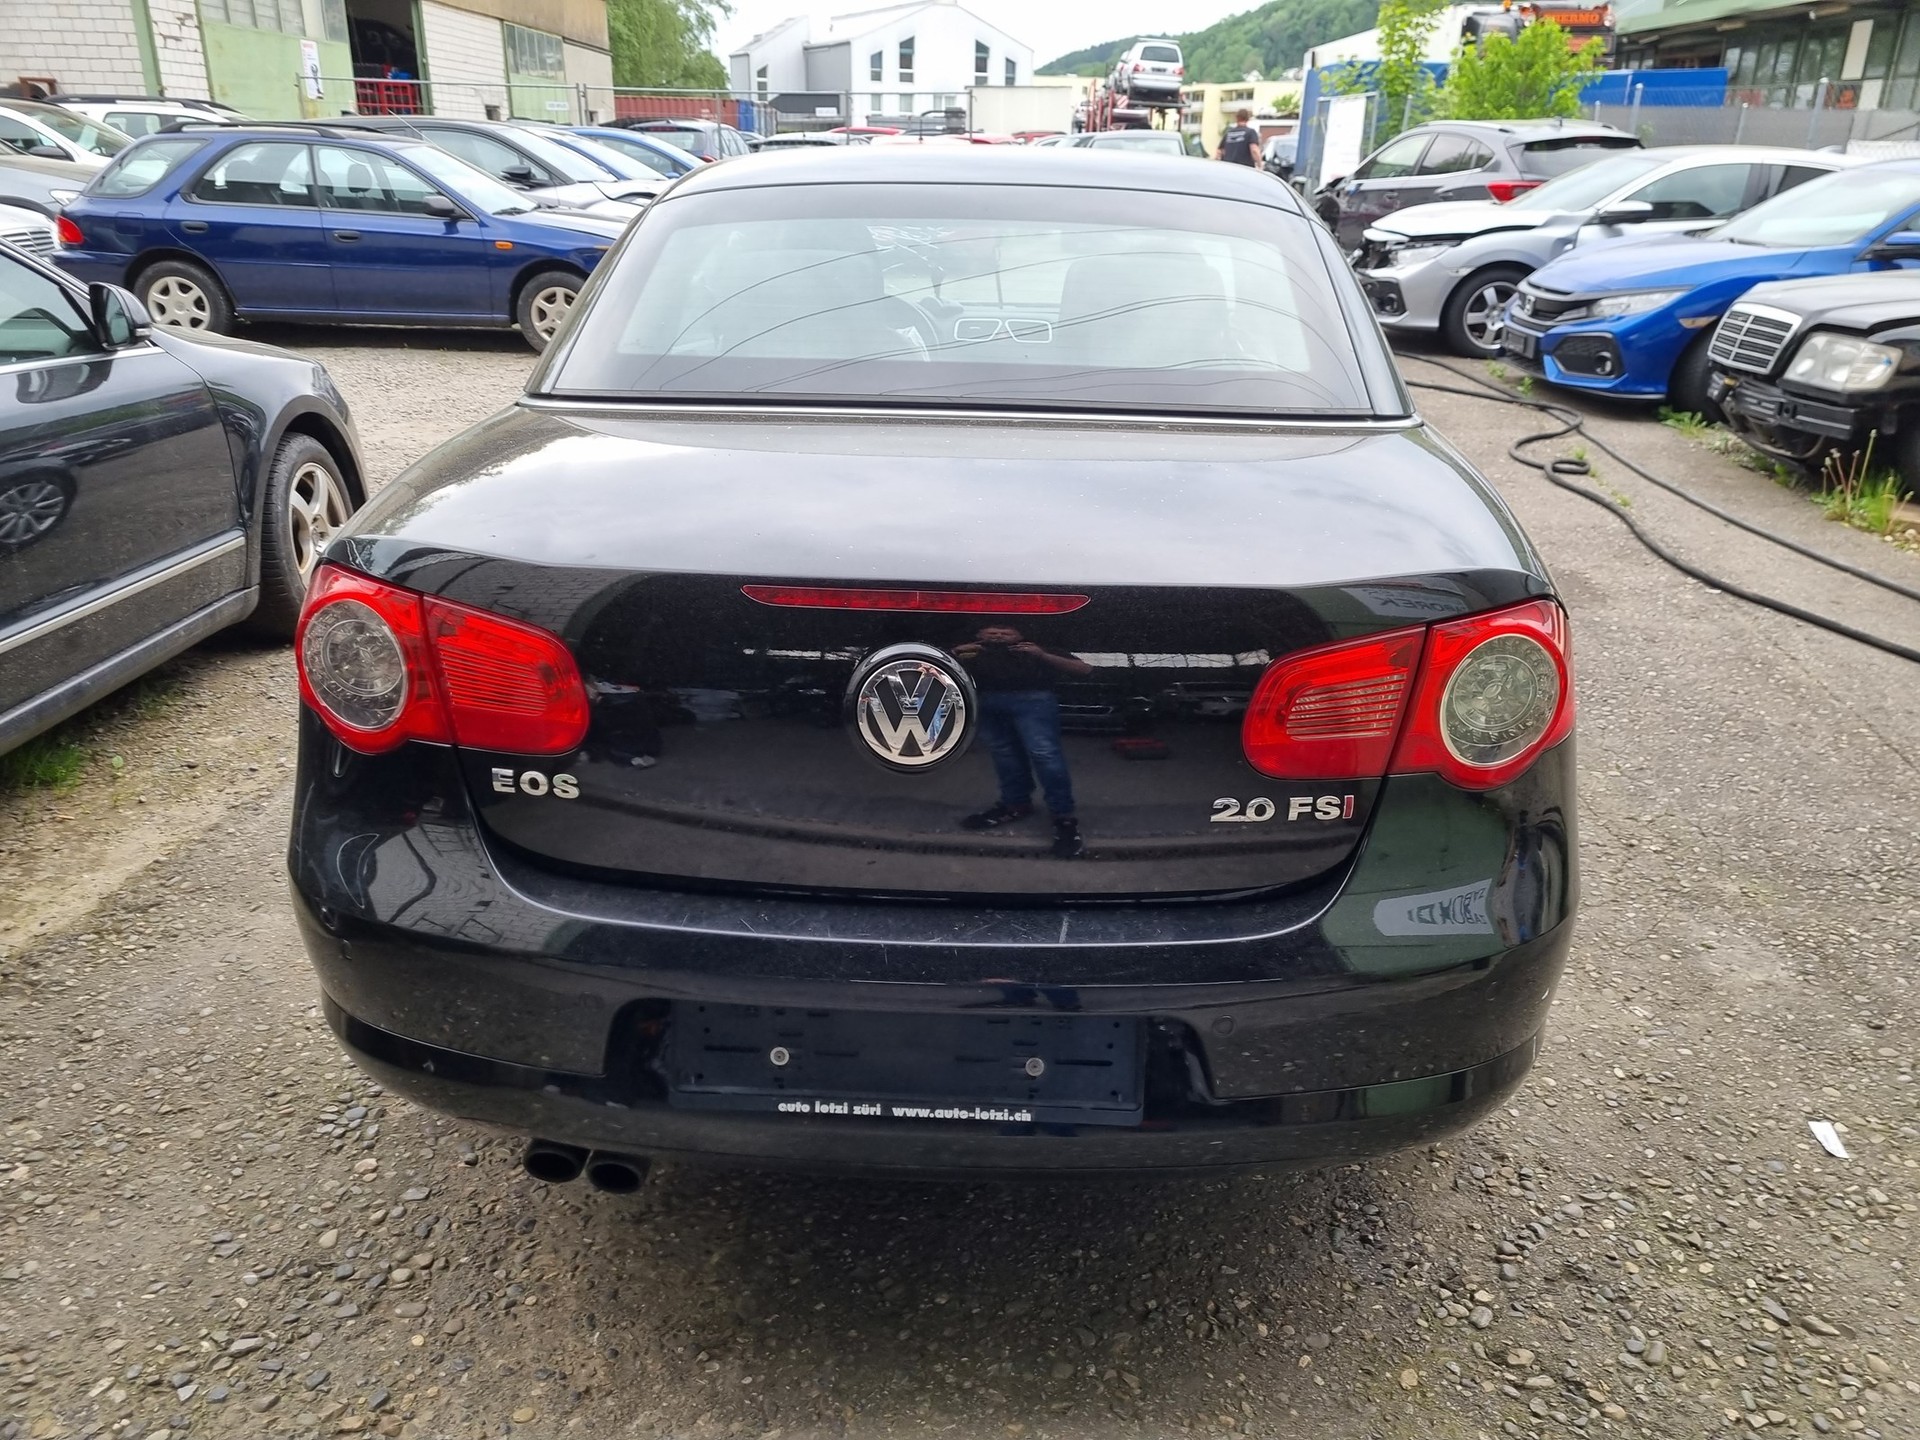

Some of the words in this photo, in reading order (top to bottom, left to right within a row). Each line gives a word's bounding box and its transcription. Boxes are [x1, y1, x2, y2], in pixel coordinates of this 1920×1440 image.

[1549, 13, 1600, 25] HERMO
[491, 767, 580, 799] EOS
[1287, 795, 1355, 821] FSI
[777, 1101, 811, 1113] auto
